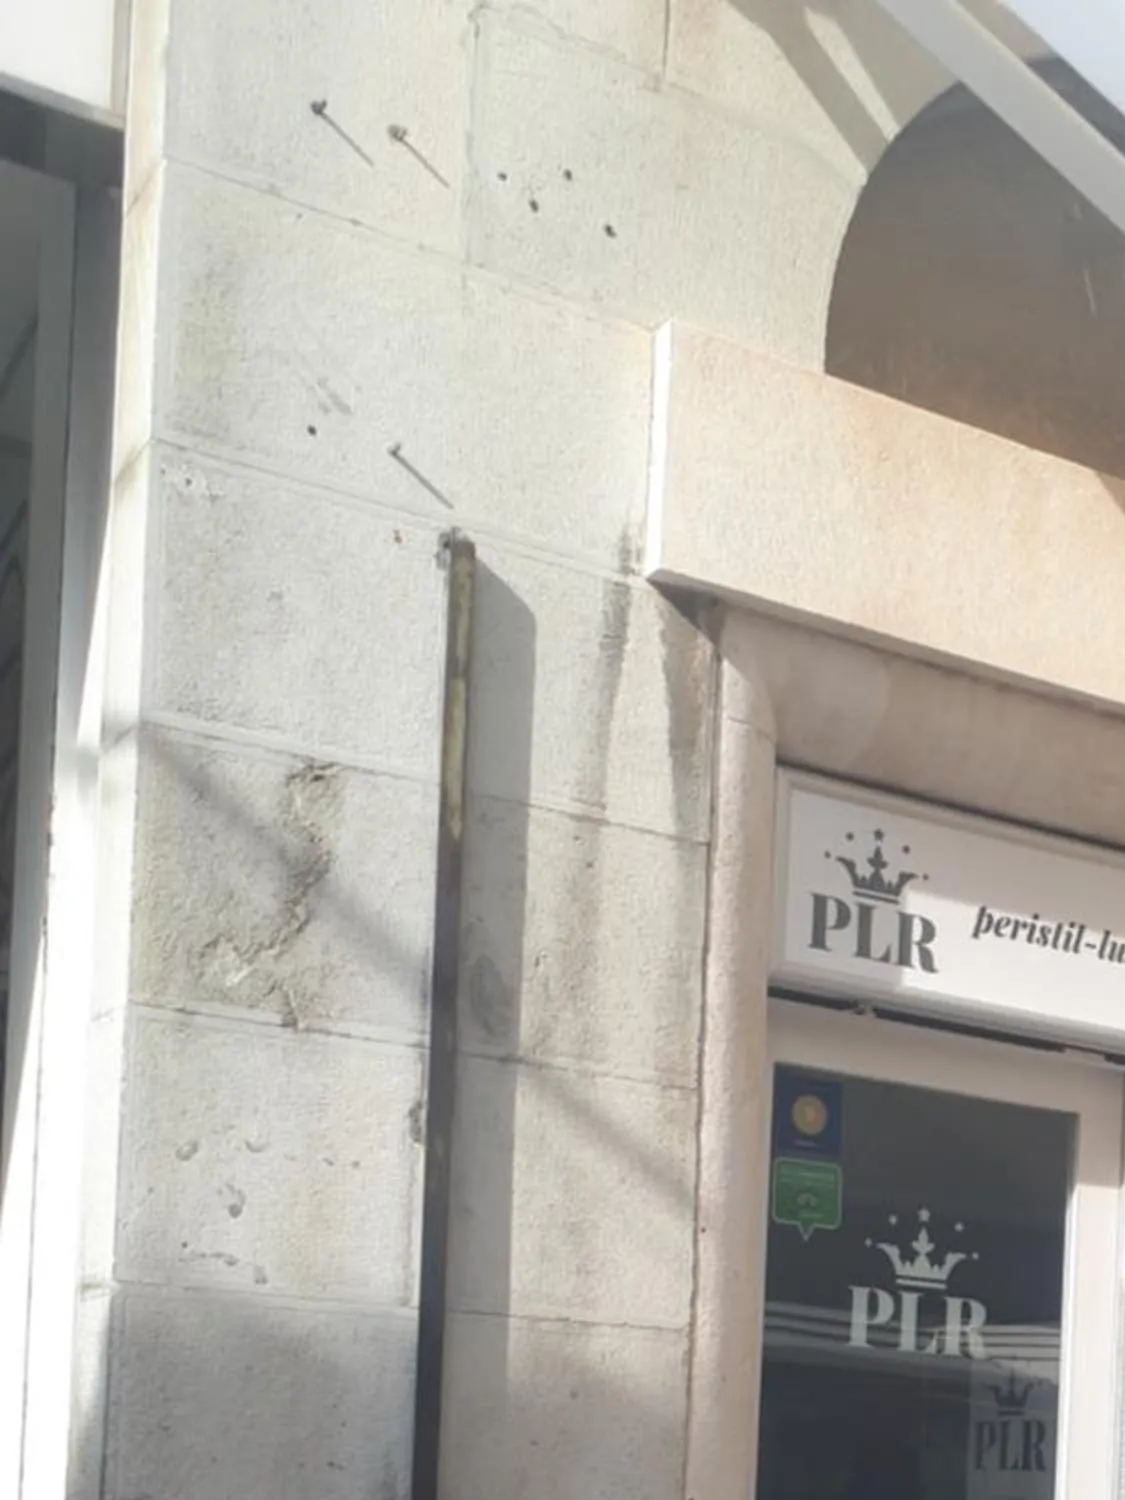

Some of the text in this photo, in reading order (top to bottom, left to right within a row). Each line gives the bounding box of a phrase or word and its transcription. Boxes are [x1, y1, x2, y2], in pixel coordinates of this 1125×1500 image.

[807, 891, 939, 974] PLR
[848, 1285, 989, 1360] PLR
[974, 1420, 1047, 1473] PLR
